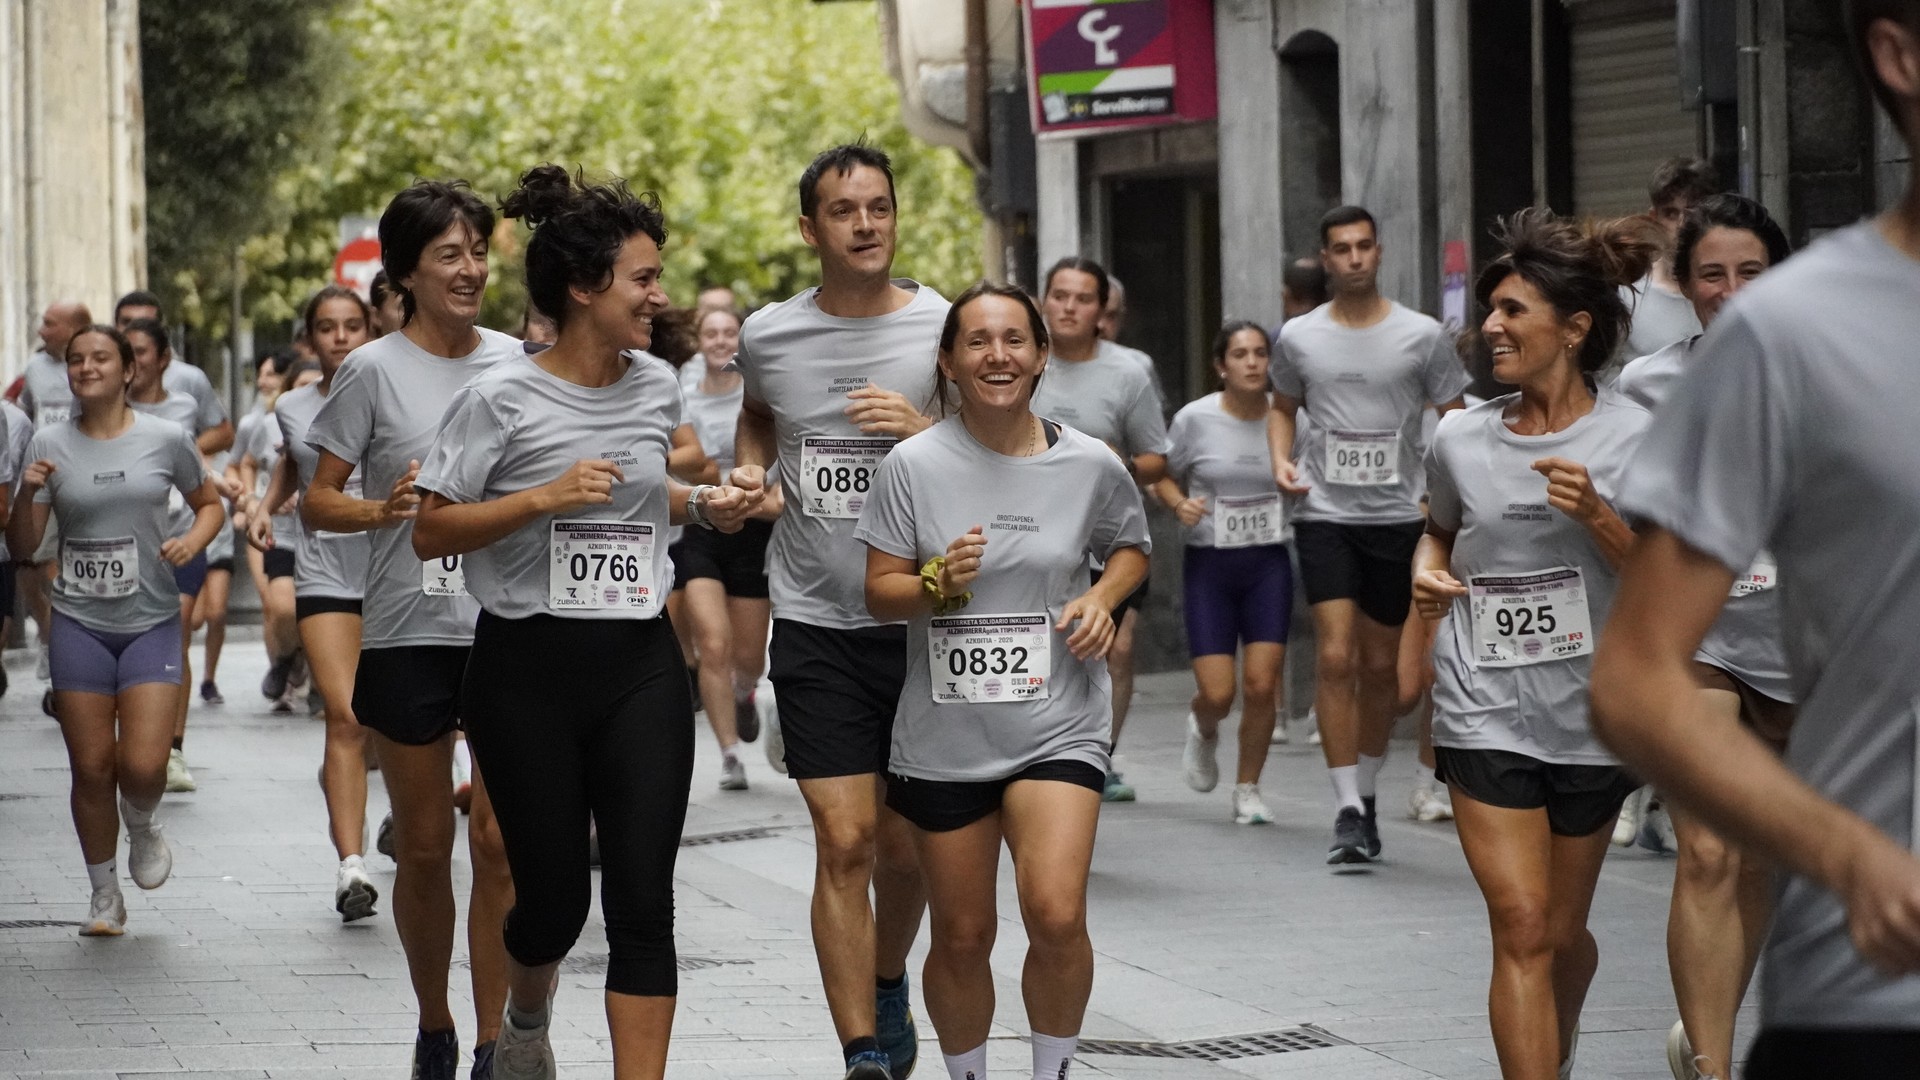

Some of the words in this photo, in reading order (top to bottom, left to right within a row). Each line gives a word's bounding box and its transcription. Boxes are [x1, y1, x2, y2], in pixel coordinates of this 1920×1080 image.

[1336, 449, 1385, 468] 0810
[816, 466, 878, 493] 088
[990, 522, 1019, 531] BIHOTZEAN
[1019, 524, 1040, 532] DIRAUTE
[996, 514, 1035, 523] OROITZAPENEK
[1226, 512, 1269, 531] 0115
[74, 559, 124, 579] 0679
[569, 553, 639, 583] 0766
[1752, 574, 1768, 583] P3
[942, 619, 979, 627] LASTERKETA
[979, 618, 1009, 626] SOLIDARIO
[1009, 616, 1044, 624] INKLUSIBOA
[1495, 604, 1557, 637] 925
[948, 645, 1029, 676] 0832
[1029, 677, 1043, 686] P3
